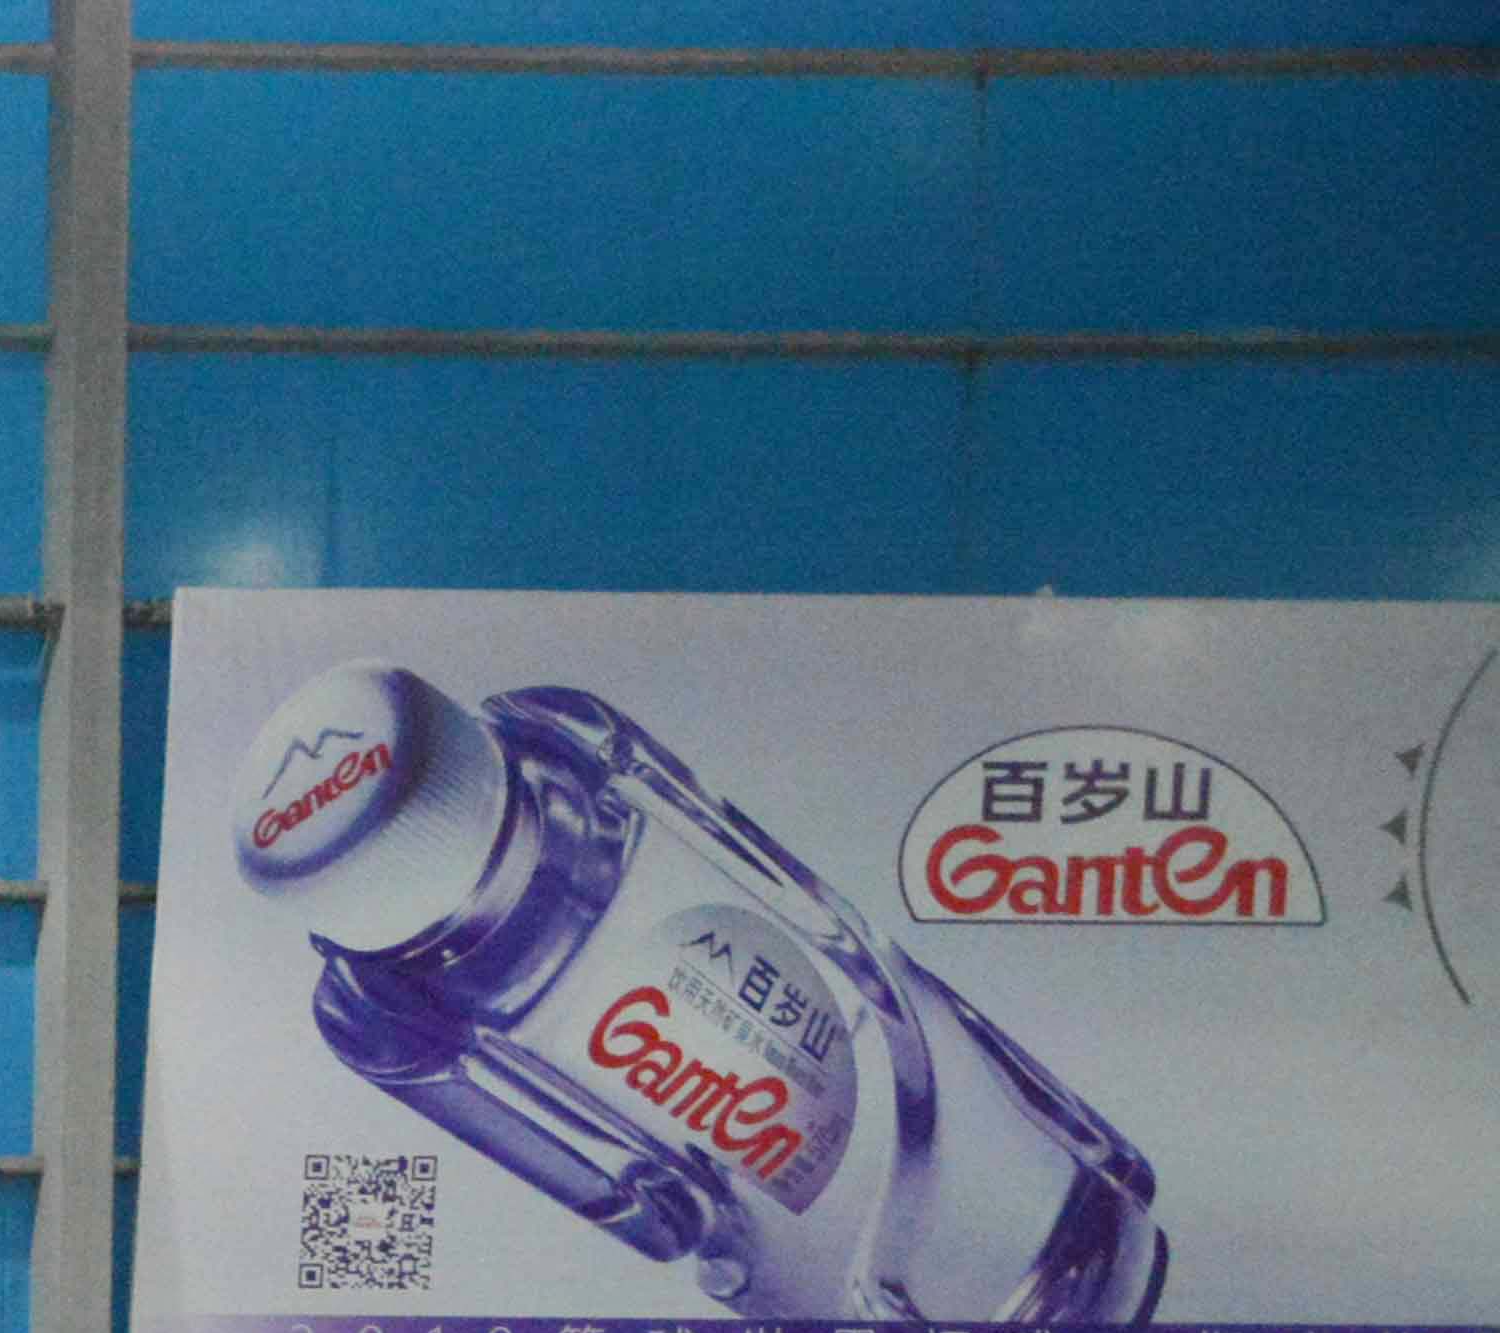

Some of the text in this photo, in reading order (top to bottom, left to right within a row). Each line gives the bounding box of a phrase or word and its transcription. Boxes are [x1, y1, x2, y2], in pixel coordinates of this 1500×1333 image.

[980, 760, 1213, 824] 百岁山
[926, 823, 1289, 918] Ganten
[738, 954, 837, 1063] 百岁山
